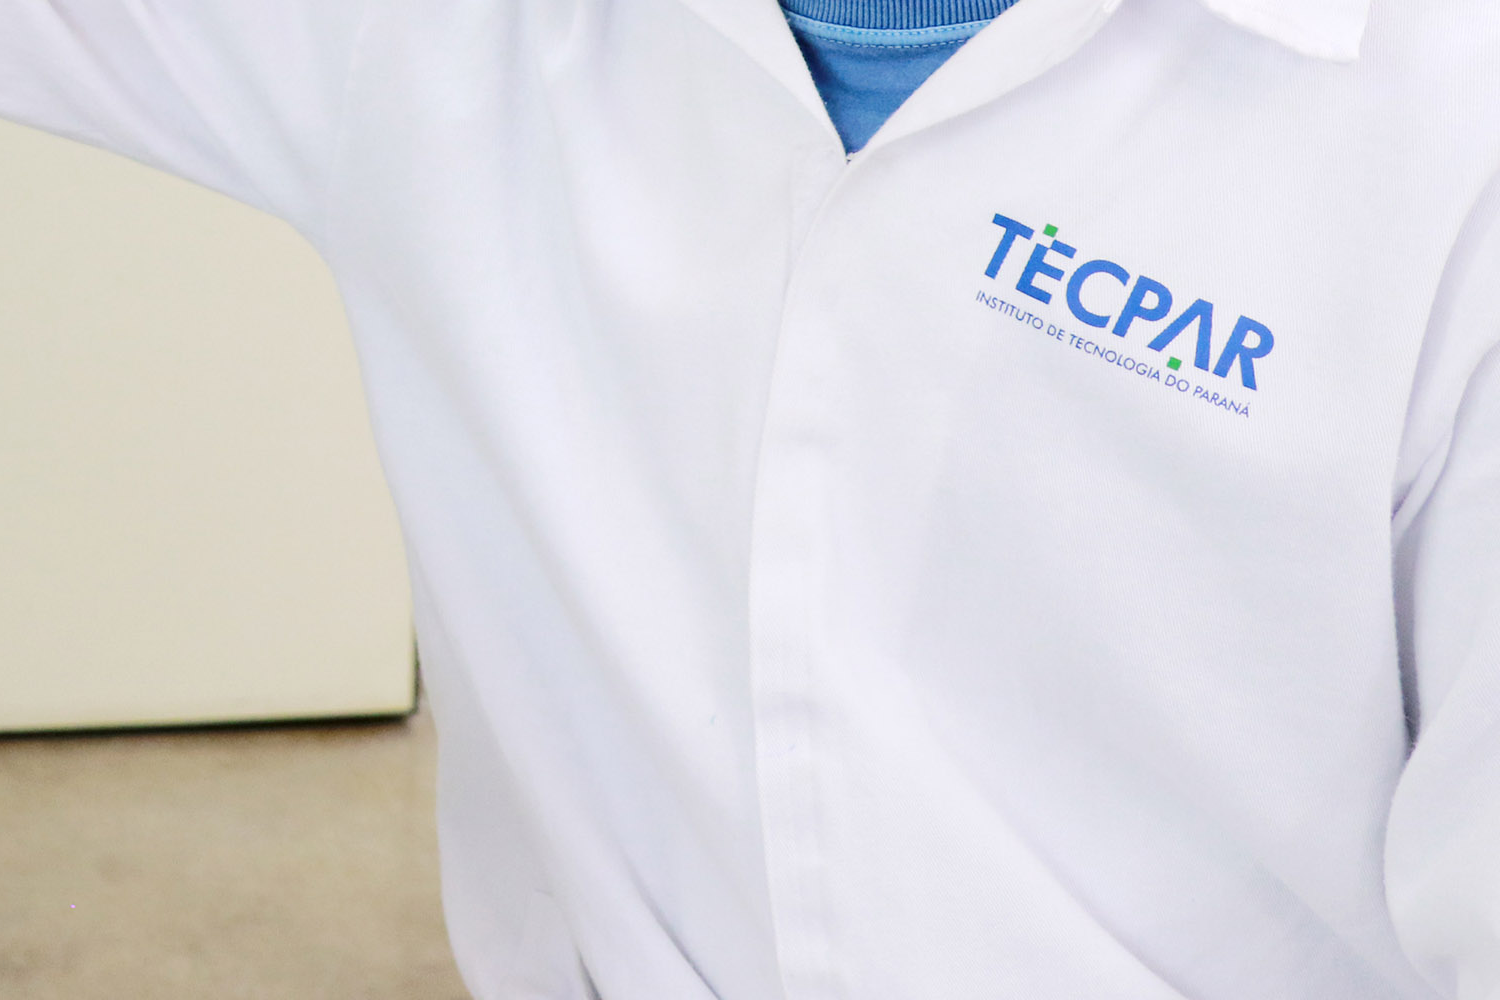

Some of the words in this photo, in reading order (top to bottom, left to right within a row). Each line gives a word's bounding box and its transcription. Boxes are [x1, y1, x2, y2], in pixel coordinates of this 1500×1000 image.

[975, 290, 1044, 331] INSTITUTO
[1046, 324, 1065, 341] DE
[1068, 332, 1160, 382] TECNOLOGIA
[1165, 374, 1190, 393] DO
[1192, 384, 1250, 418] PARANÁ
